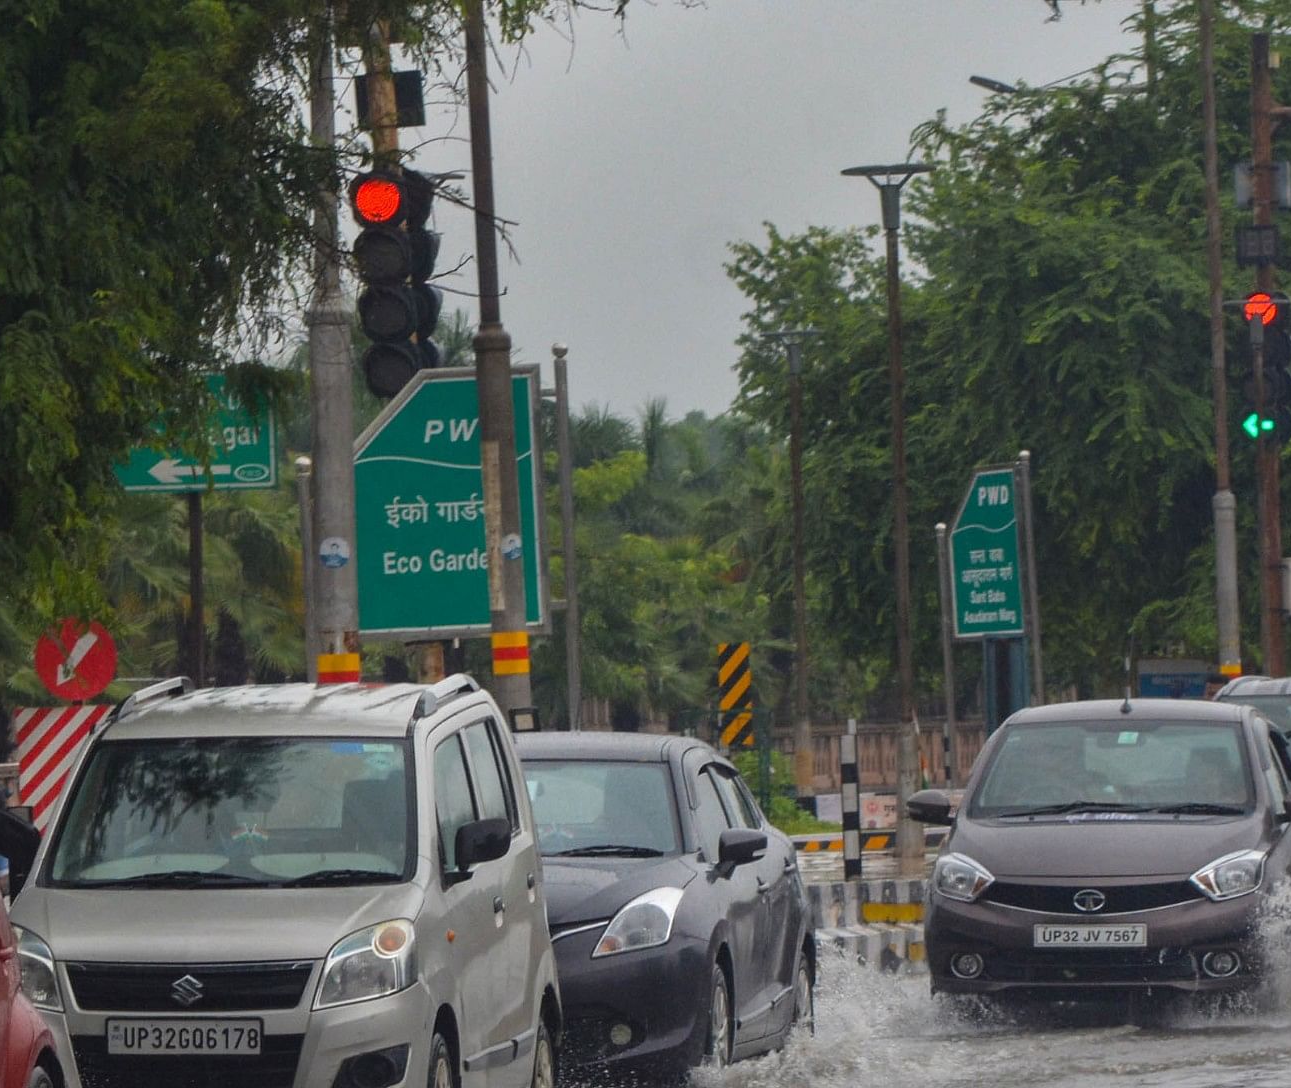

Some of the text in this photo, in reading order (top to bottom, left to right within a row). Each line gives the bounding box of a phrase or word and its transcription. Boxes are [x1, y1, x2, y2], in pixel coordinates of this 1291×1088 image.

[423, 418, 479, 443] PW
[977, 484, 1009, 507] PWD
[384, 496, 429, 528] ईको
[383, 548, 489, 575] Eco Garde
[1042, 930, 1139, 942] UP32 JV 7567
